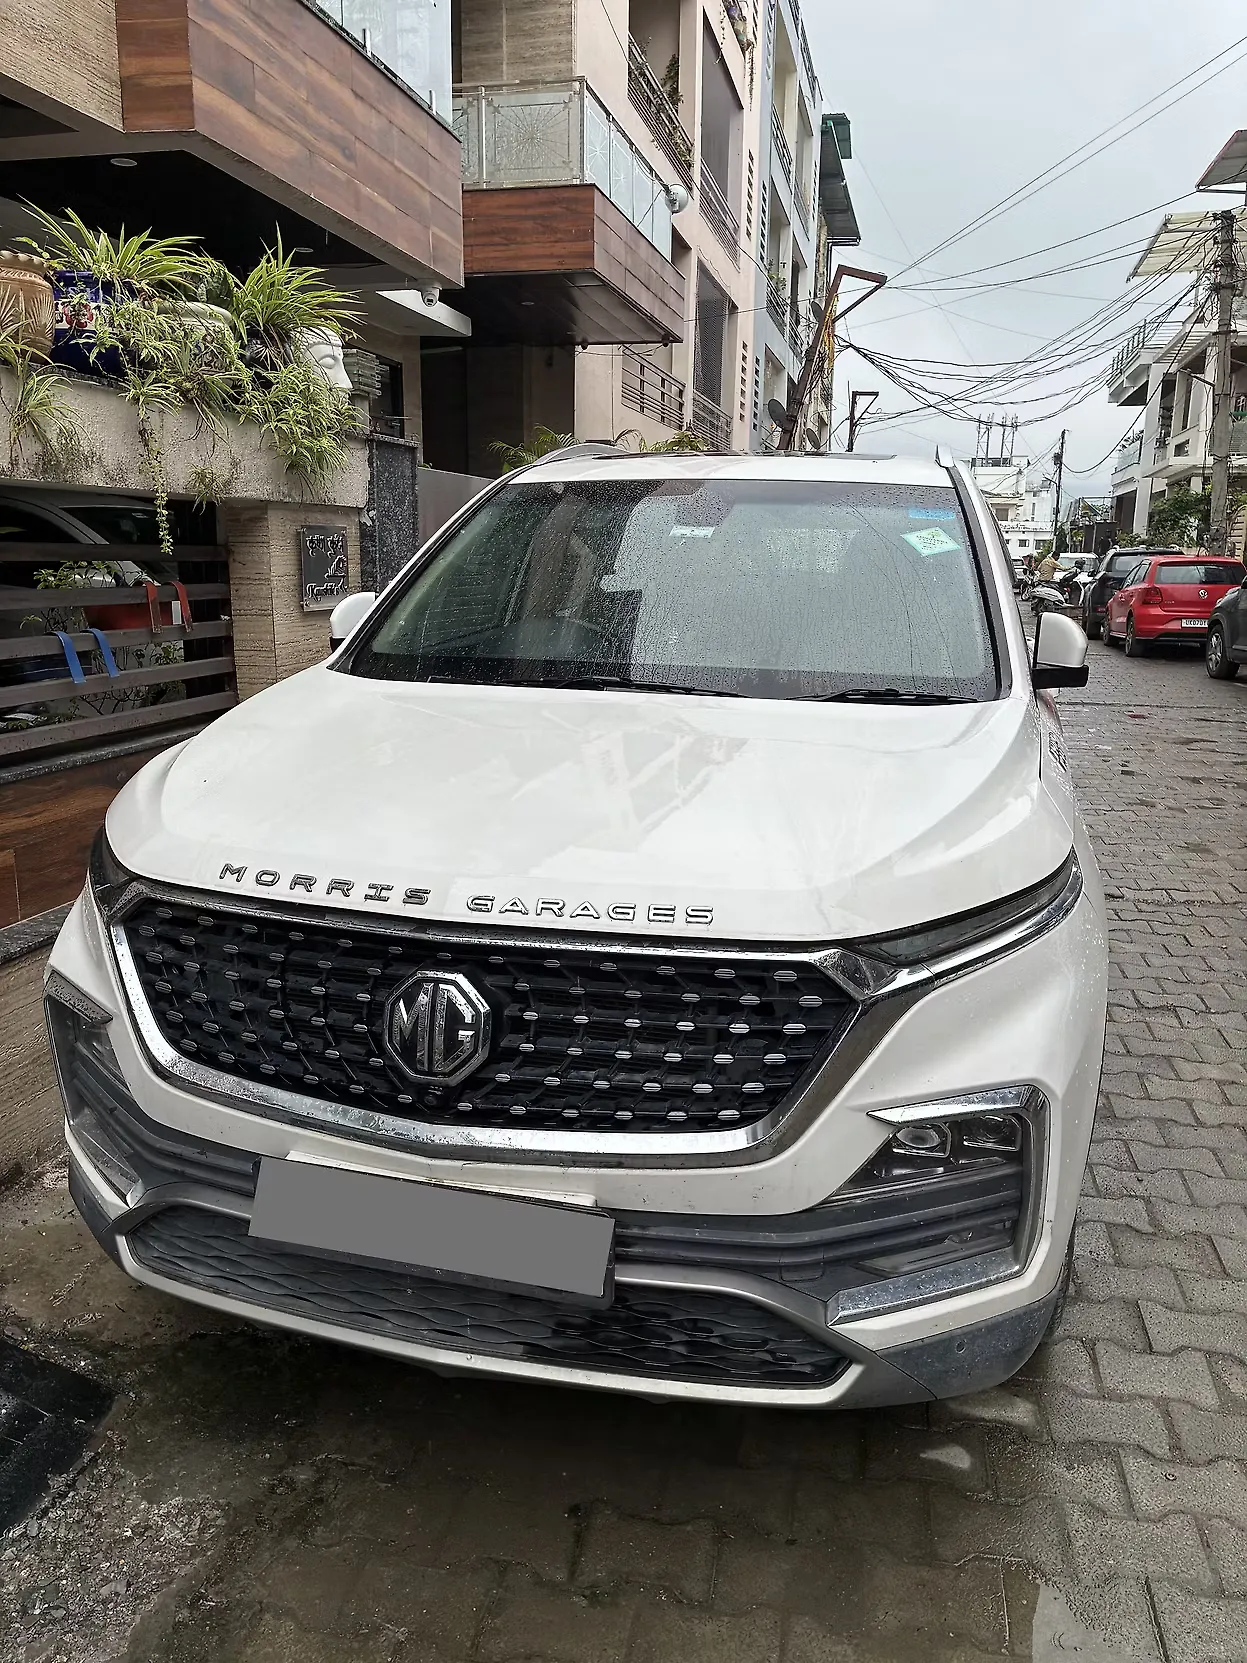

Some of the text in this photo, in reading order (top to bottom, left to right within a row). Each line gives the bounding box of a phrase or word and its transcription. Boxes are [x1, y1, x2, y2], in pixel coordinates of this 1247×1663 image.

[219, 862, 714, 925] MORRIS GARAGES
[390, 981, 477, 1073] MG
